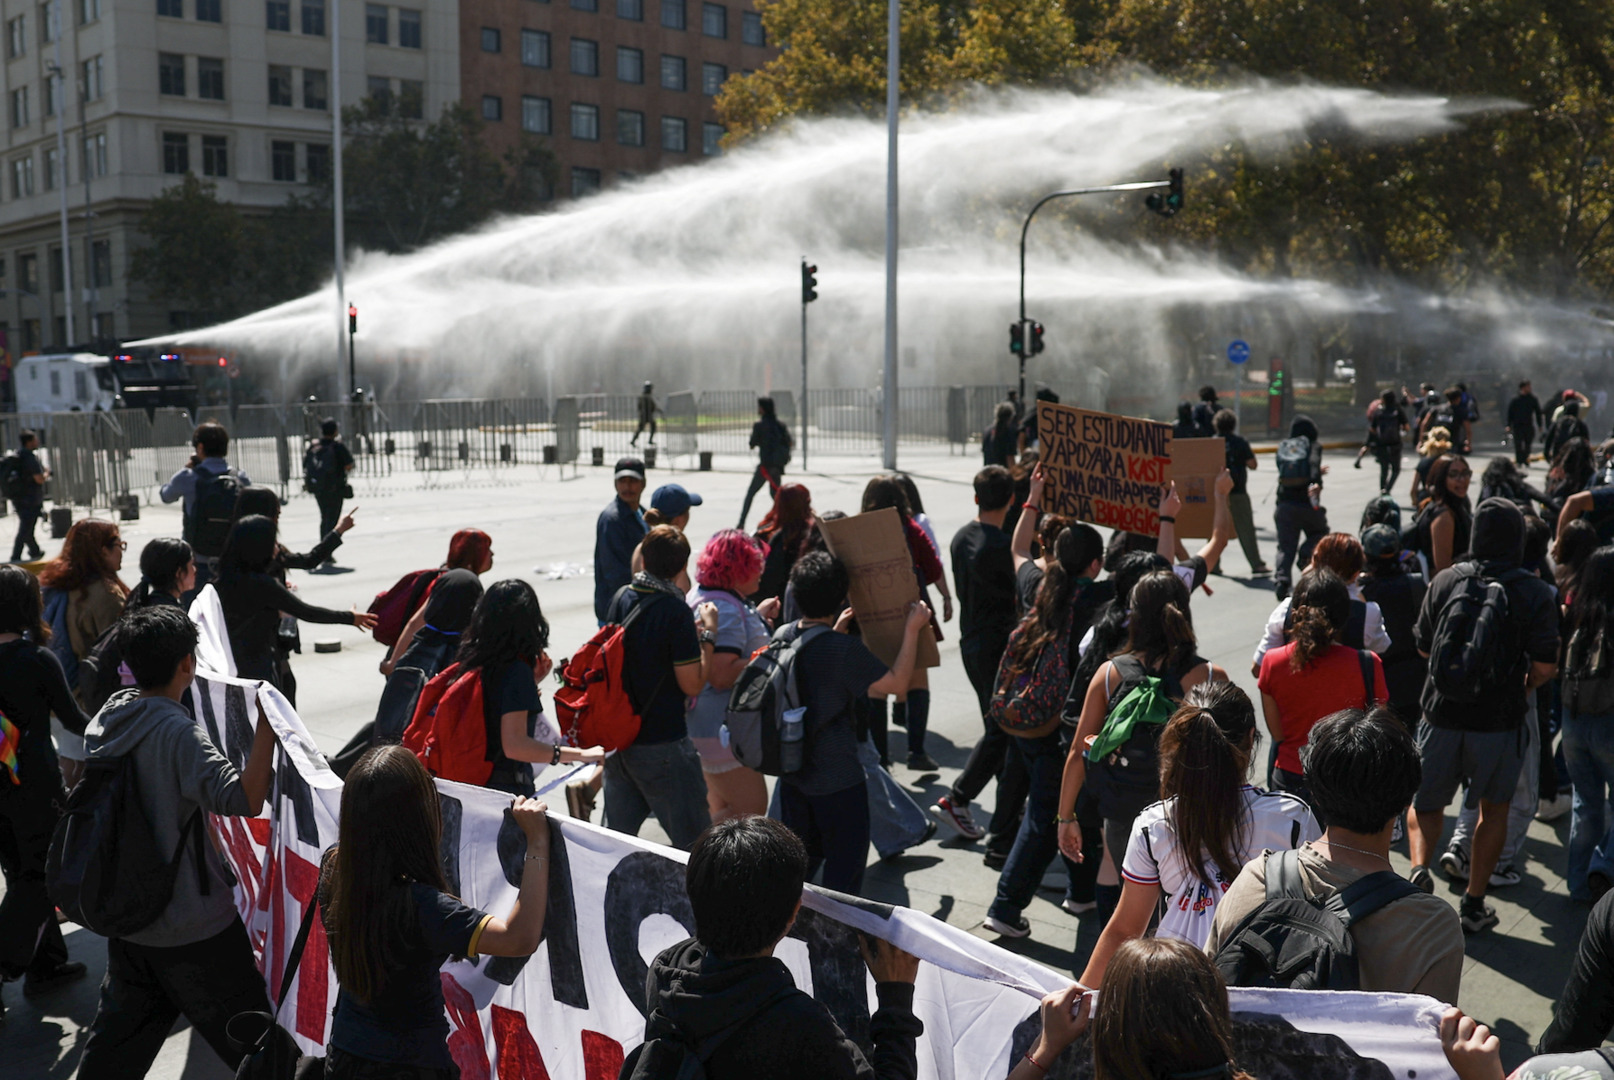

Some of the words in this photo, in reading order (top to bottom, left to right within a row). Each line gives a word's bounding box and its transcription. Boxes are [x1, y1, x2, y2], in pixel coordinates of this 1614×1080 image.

[1041, 407, 1077, 439] SER
[1083, 415, 1173, 458] ESTUDIANTE
[1060, 468, 1086, 494] UNA
[1128, 455, 1172, 483] KAST
[1043, 484, 1095, 522] HASTA
[1094, 499, 1160, 536] BIOLÓGIC
